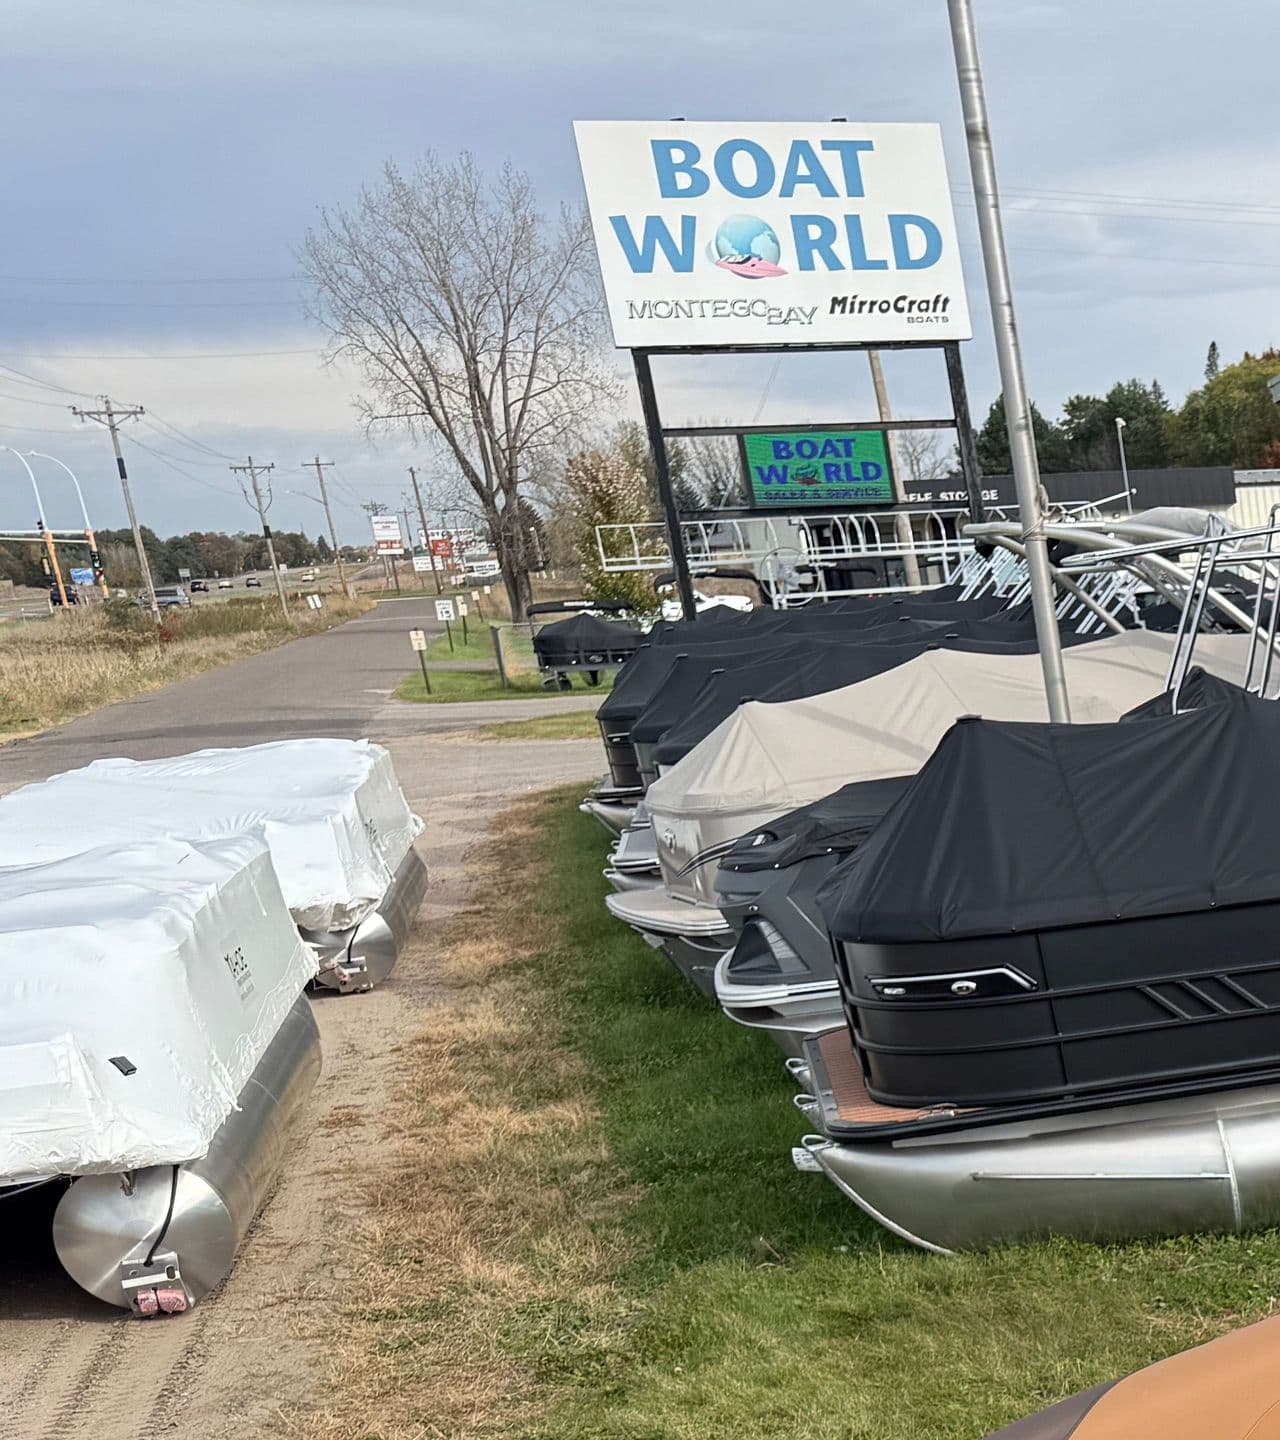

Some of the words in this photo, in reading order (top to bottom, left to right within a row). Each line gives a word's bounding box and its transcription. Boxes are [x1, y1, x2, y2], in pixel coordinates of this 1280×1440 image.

[650, 137, 874, 199] BOAT
[828, 293, 951, 316] MirroCraft
[906, 315, 950, 324] BOATS
[771, 438, 857, 460] BOAT
[905, 492, 933, 502] ELF
[939, 489, 999, 501] STOGE
